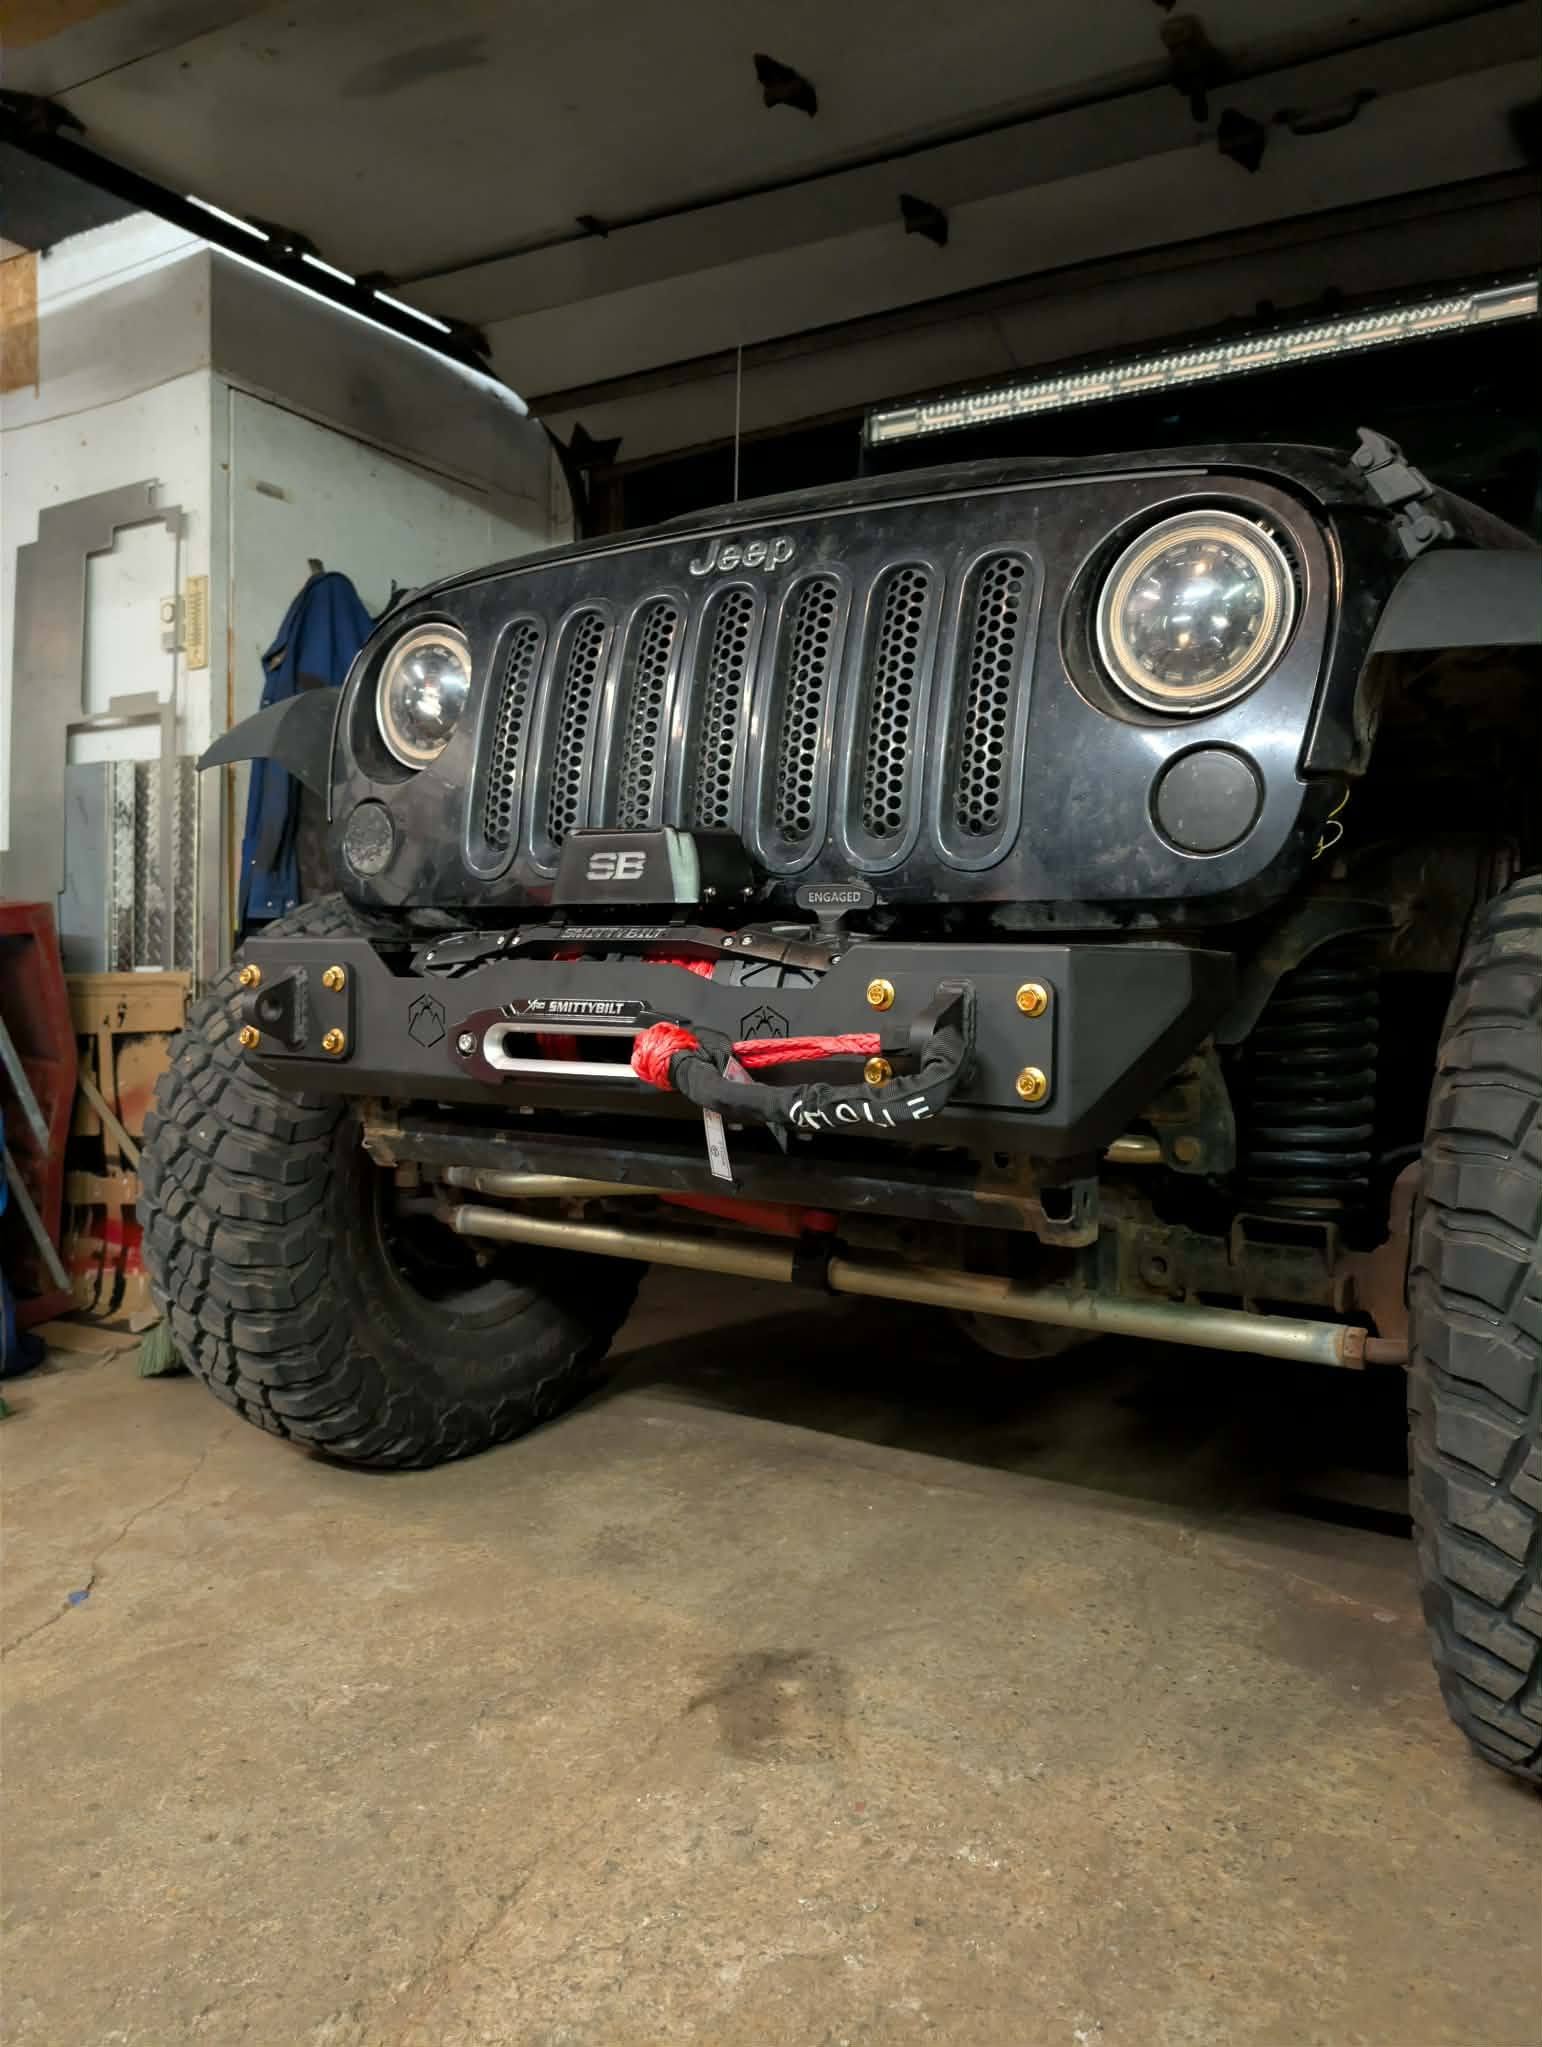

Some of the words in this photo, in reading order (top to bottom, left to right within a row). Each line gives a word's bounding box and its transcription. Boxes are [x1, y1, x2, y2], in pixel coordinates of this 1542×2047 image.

[689, 536, 796, 575] Jeep
[808, 891, 861, 903] ENGAGED
[561, 927, 667, 938] SMITTYBILT
[548, 1001, 625, 1014] SMITTYBILT
